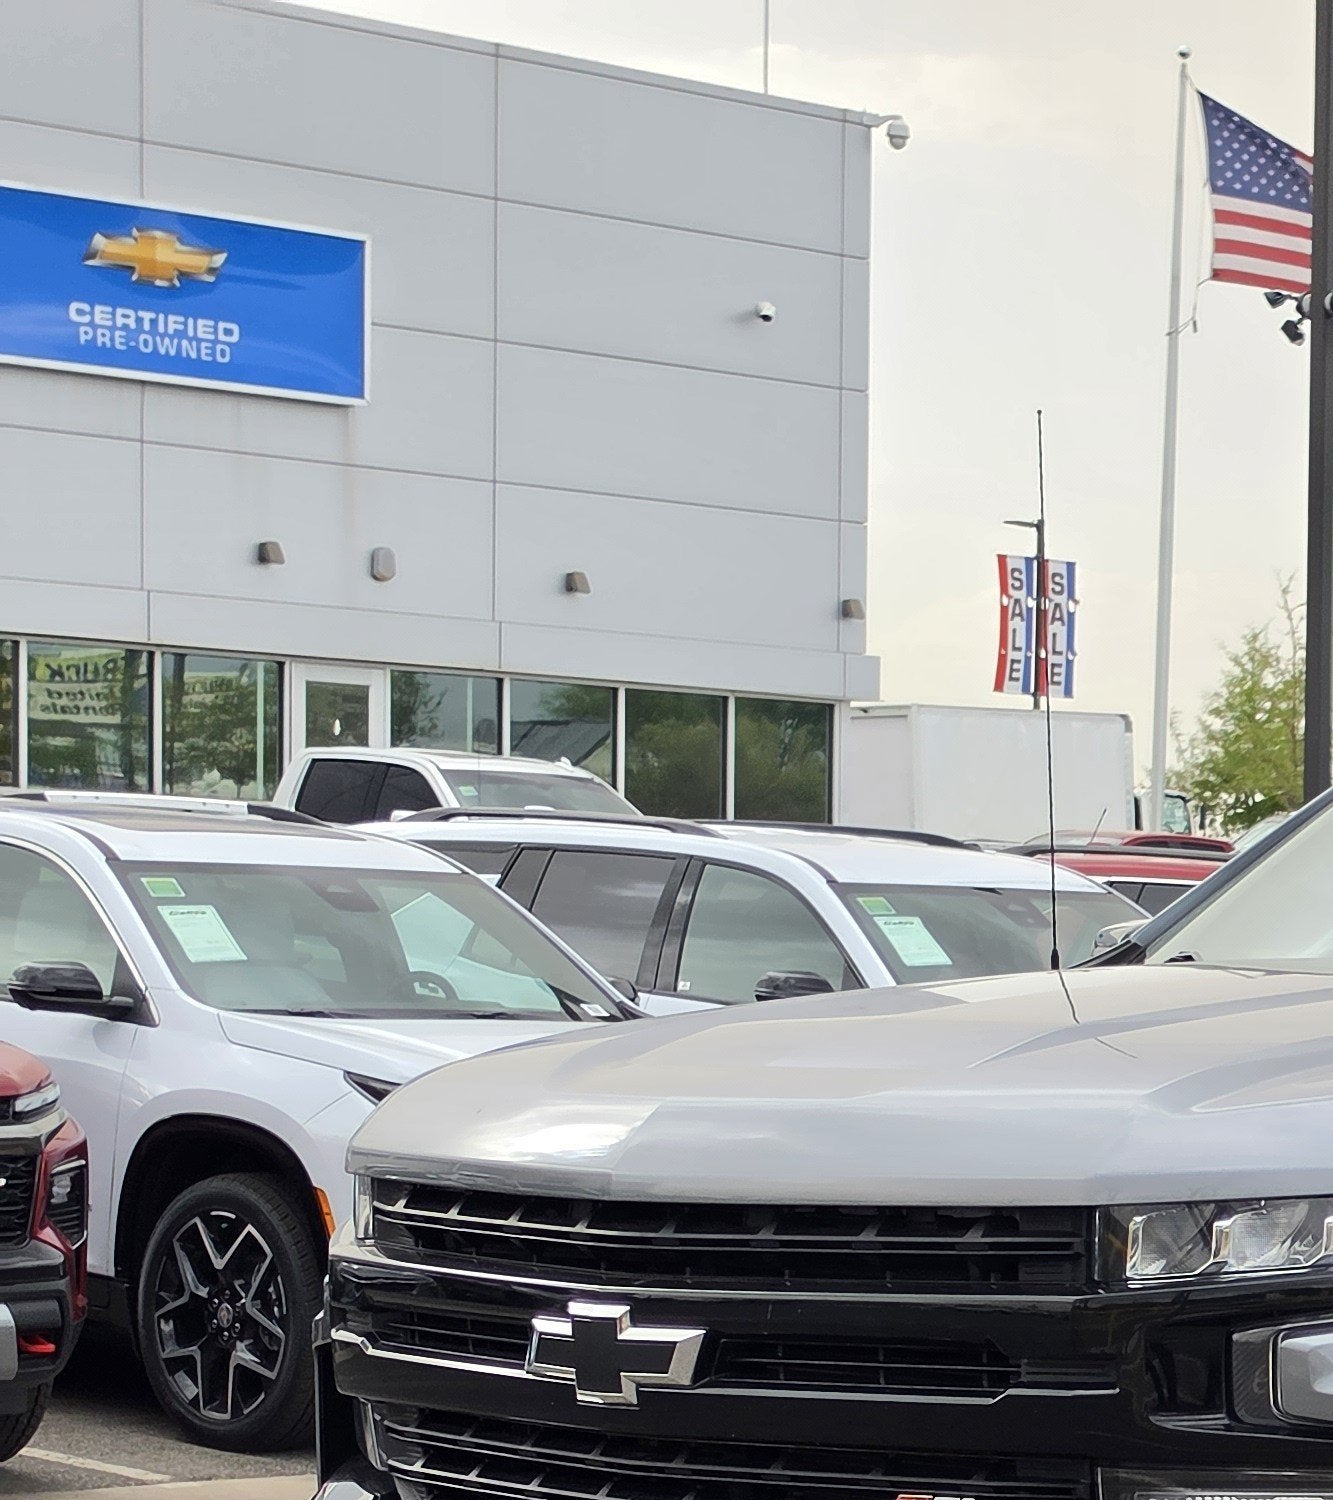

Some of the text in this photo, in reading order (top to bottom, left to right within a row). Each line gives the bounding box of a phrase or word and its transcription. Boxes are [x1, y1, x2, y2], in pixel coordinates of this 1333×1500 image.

[68, 301, 240, 344] CERTIFIED
[78, 325, 231, 363] PRE-OWNED
[1009, 567, 1025, 682] SALE
[1050, 572, 1066, 687] SALE
